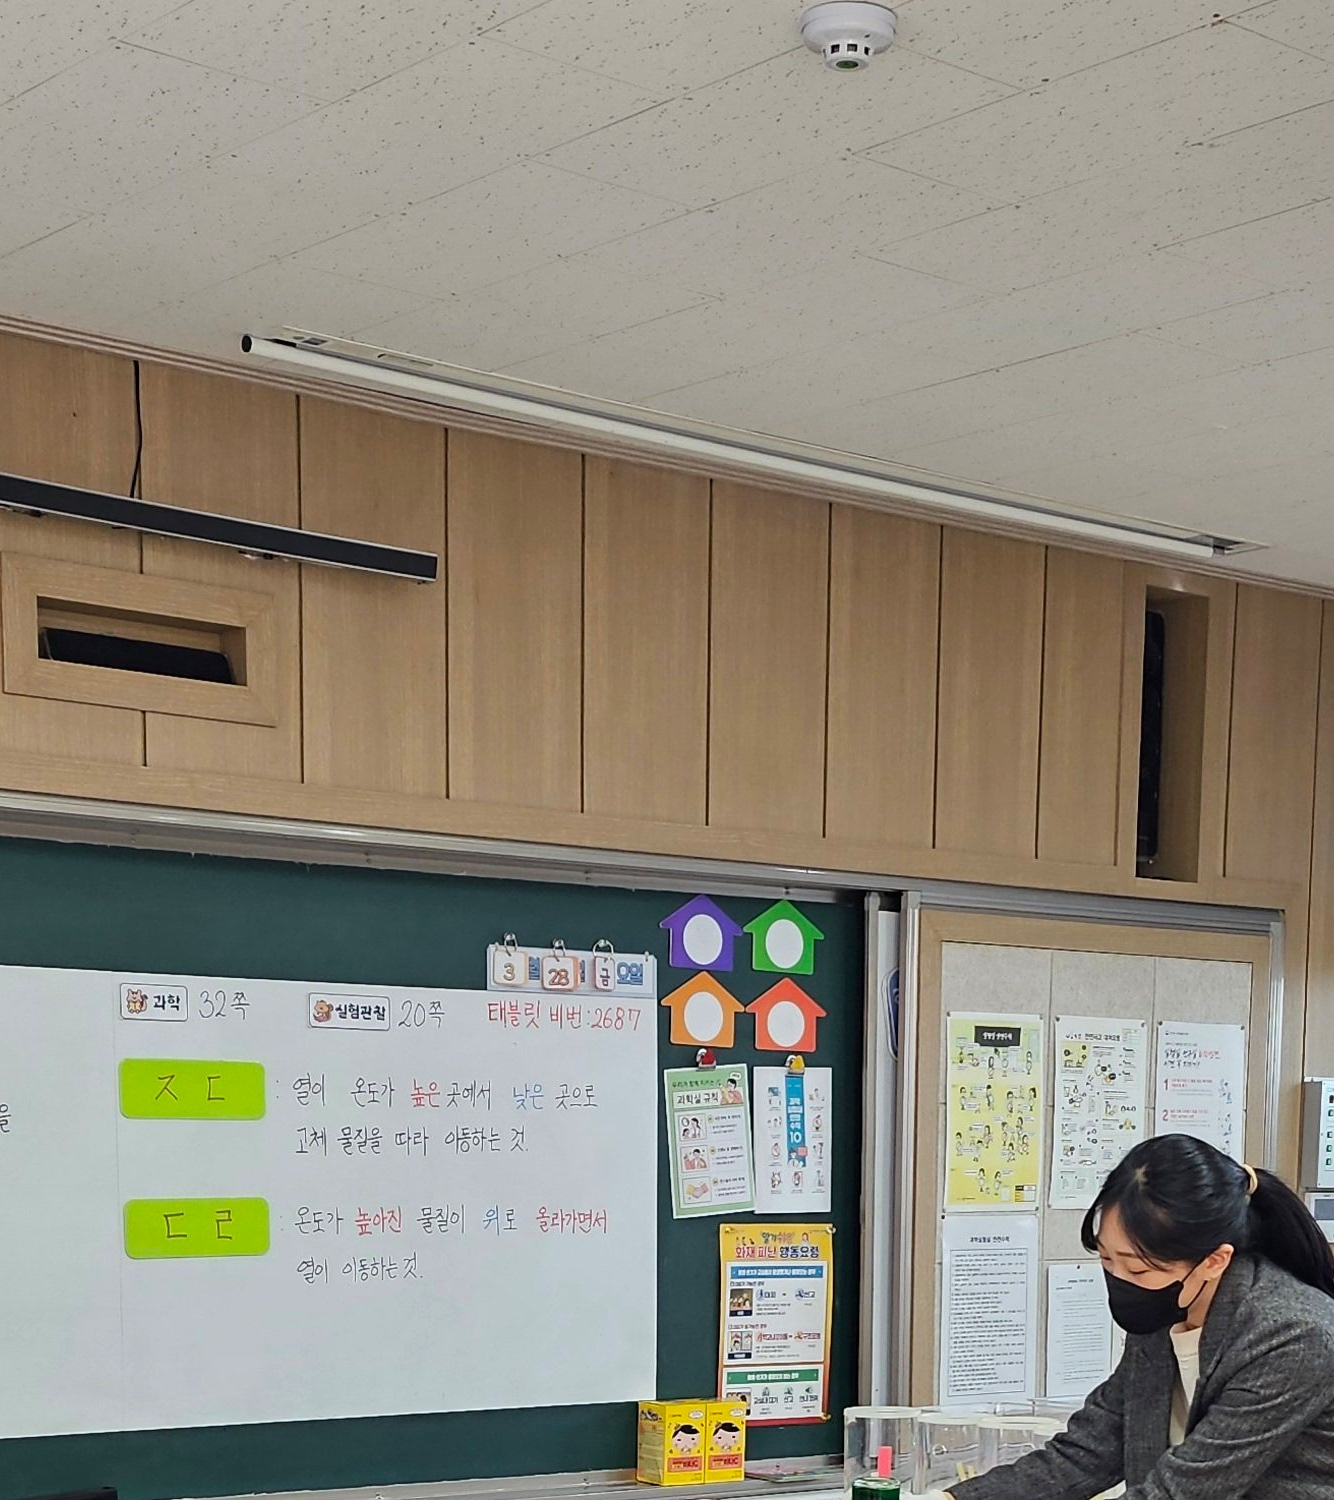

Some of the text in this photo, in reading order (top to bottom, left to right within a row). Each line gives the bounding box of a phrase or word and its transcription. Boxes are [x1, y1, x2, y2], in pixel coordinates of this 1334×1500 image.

[502, 961, 645, 987] 3 28 금 요일
[153, 994, 180, 1011] 과학
[198, 990, 251, 1021] 32쪽
[335, 1004, 386, 1023] 실험관찰
[398, 1001, 446, 1029] 20쪽
[486, 999, 540, 1030] 태블릿
[292, 1073, 597, 1111] 열이 온도가 높은 곳에서 낮은 곳으로
[677, 1091, 719, 1105] 과학실 규칙
[1162, 1108, 1169, 1122] 2
[295, 1125, 529, 1157] 고체 물질을 따라 이동하는 것.
[789, 1131, 803, 1144] 10
[294, 1204, 608, 1236] 온도가 높아진 물질이 위로 올라가면서
[736, 1245, 819, 1259] 화재 피난 행동요령
[296, 1255, 328, 1284] 열이
